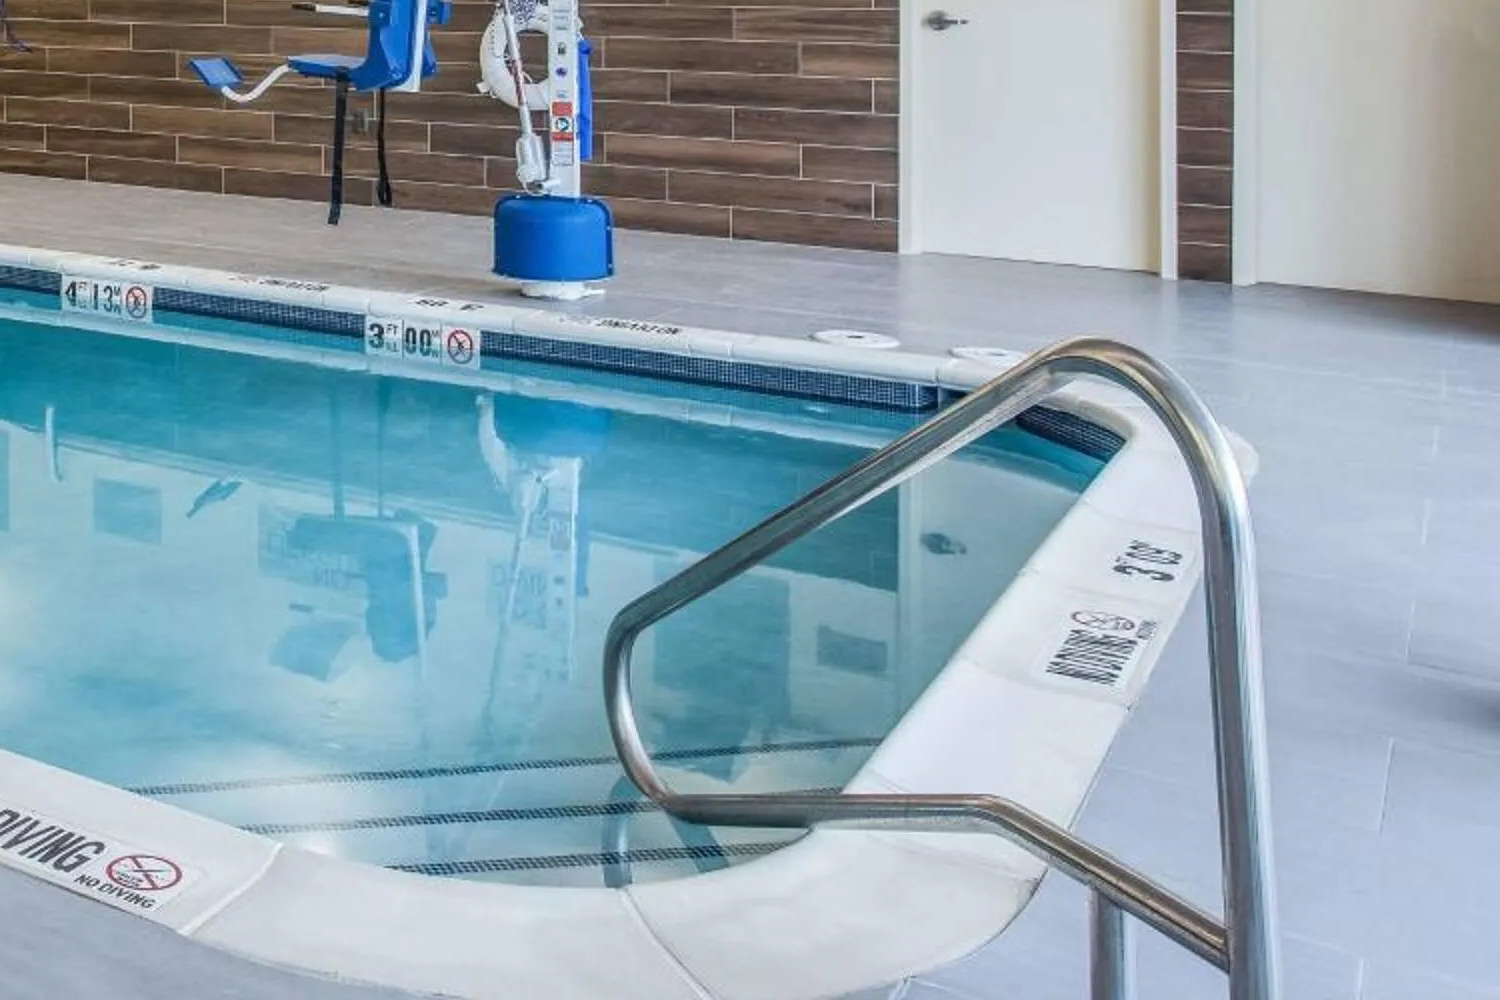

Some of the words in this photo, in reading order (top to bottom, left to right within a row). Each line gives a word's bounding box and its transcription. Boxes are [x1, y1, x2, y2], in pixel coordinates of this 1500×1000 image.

[369, 323, 385, 348] 3
[74, 874, 99, 888] NO
[99, 884, 156, 909] DIVING
